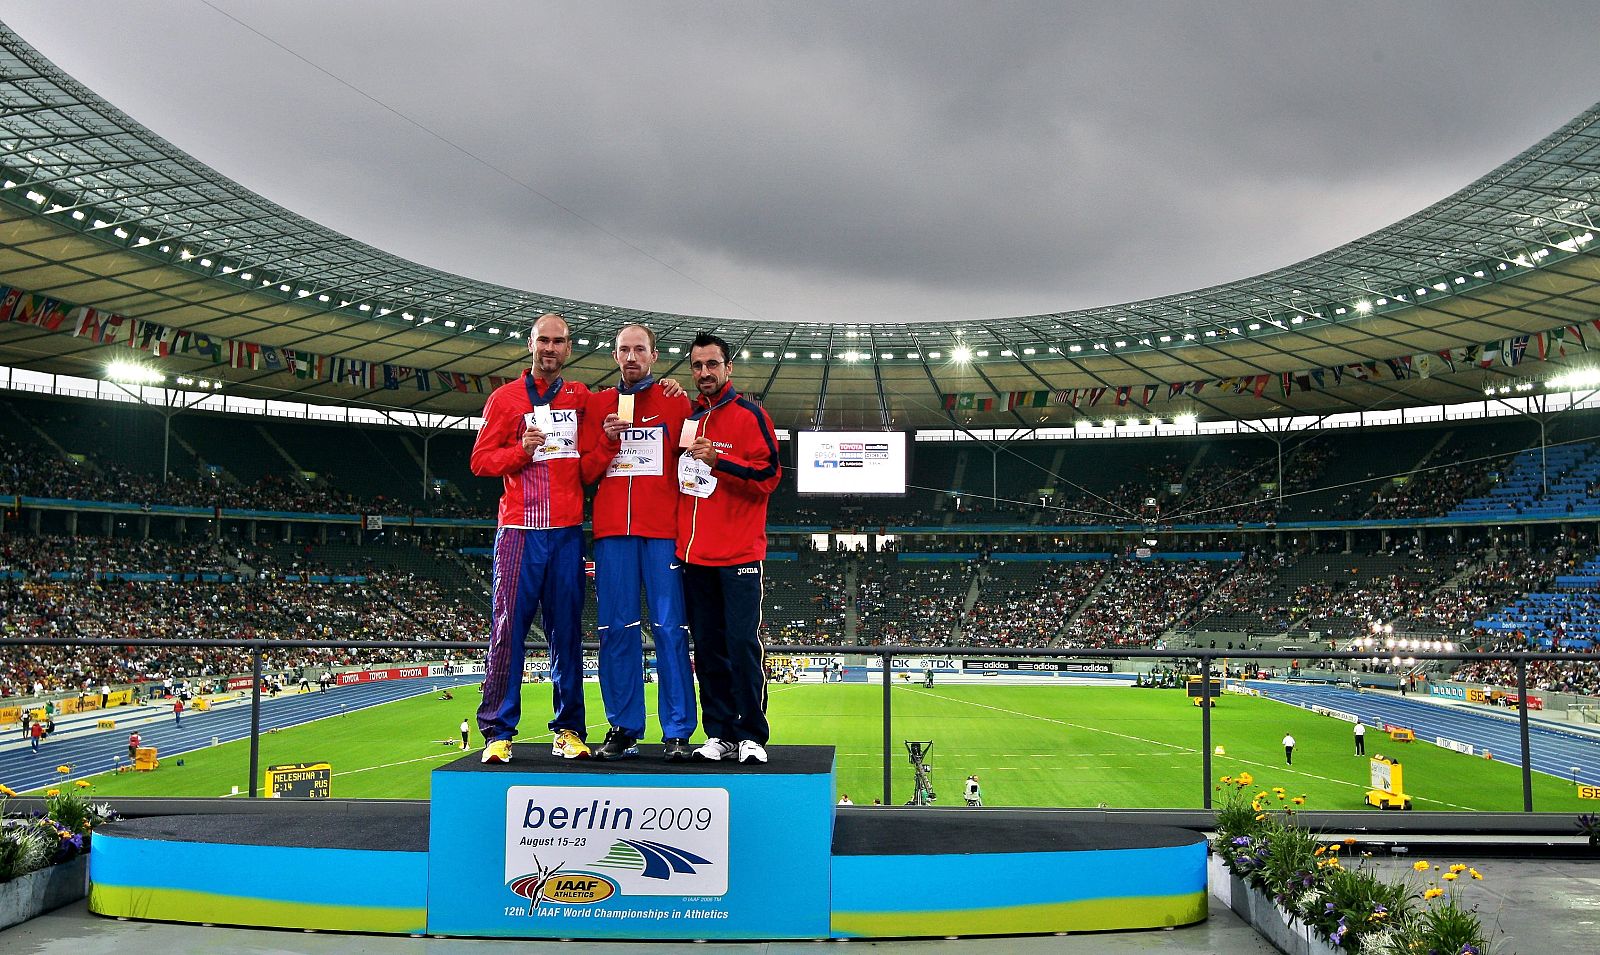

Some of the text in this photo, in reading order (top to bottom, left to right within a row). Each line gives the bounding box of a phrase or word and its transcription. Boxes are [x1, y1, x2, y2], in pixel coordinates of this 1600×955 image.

[550, 411, 575, 423] DK
[624, 429, 657, 441] TDK
[811, 657, 836, 665] TDK
[892, 659, 909, 668] DK
[928, 660, 954, 668] TDK
[984, 661, 1009, 669] adidas
[1034, 663, 1059, 671] adidas
[1083, 664, 1108, 672] adidas
[369, 671, 389, 681] TOYOTA
[399, 668, 423, 678] TOYOTA
[342, 674, 360, 684] TOYOTA
[1433, 686, 1463, 697] MONDO
[1442, 739, 1452, 748] TDK
[274, 771, 315, 783] MELESHINA
[274, 780, 329, 792] P:14 RUS
[309, 789, 328, 798] 6.14
[522, 799, 712, 832] berlin 2009
[519, 836, 554, 848] August
[555, 880, 599, 891] IAAF
[504, 906, 729, 921] 12th IAAF World Championships in Athletics
